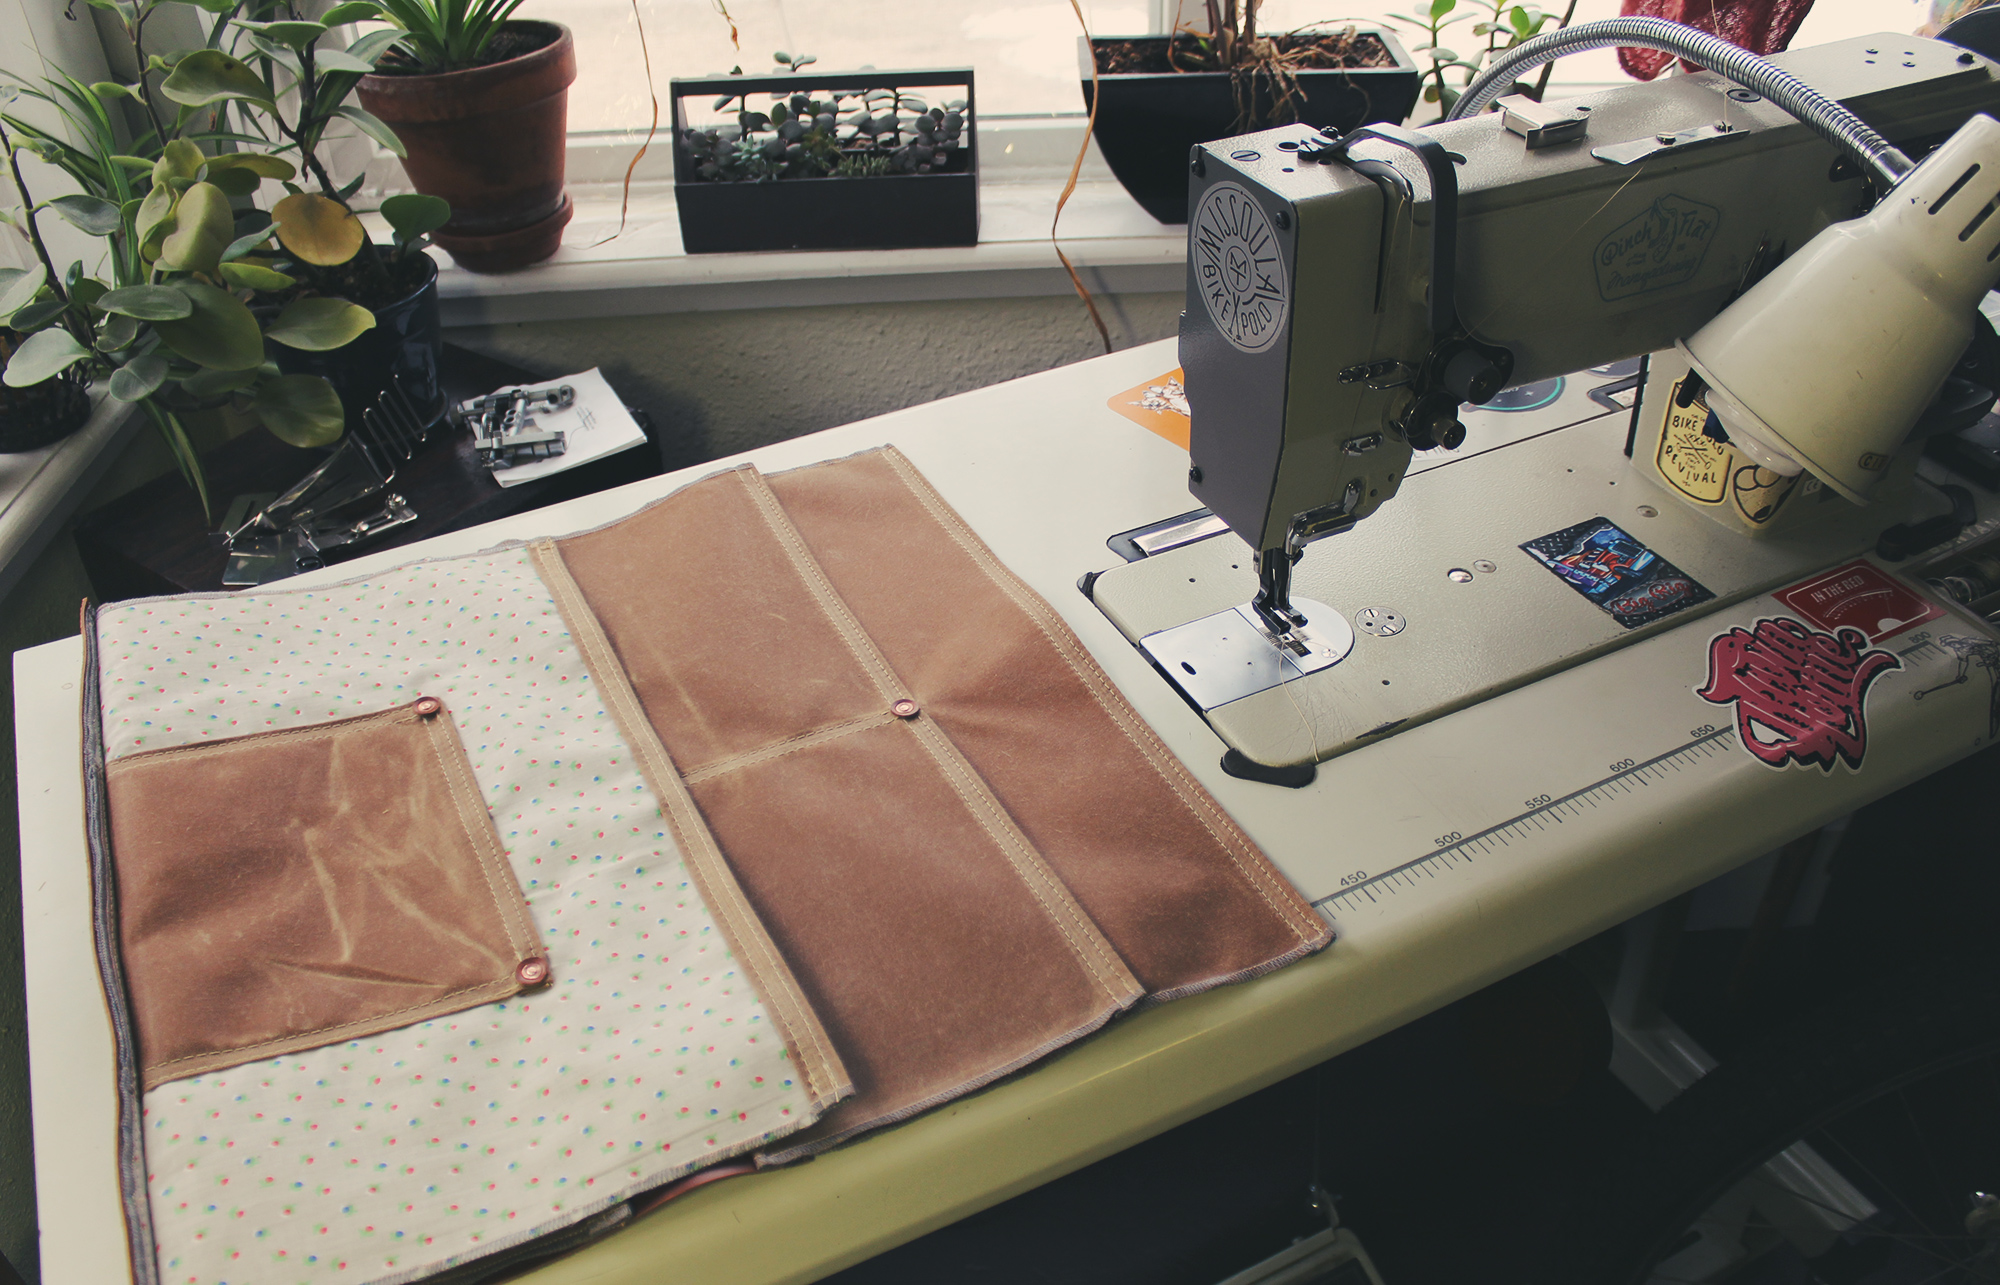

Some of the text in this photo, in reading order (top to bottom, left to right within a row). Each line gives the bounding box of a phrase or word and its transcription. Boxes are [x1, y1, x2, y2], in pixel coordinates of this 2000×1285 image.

[1199, 194, 1281, 294] MISSOULA
[1601, 209, 1712, 266] Pinch Flat
[1202, 264, 1272, 336] BIKE POLO
[1672, 415, 1698, 431] BIKE
[1665, 445, 1717, 483] REVIVAL
[1610, 581, 1692, 613] Big Rig
[1811, 575, 1865, 603] IN THE RED
[1908, 631, 1932, 644] 800
[1690, 723, 1716, 740] 650
[1609, 757, 1636, 774] 600
[1524, 793, 1552, 811] 550
[1434, 831, 1463, 849] 500
[1339, 870, 1368, 888] 450
